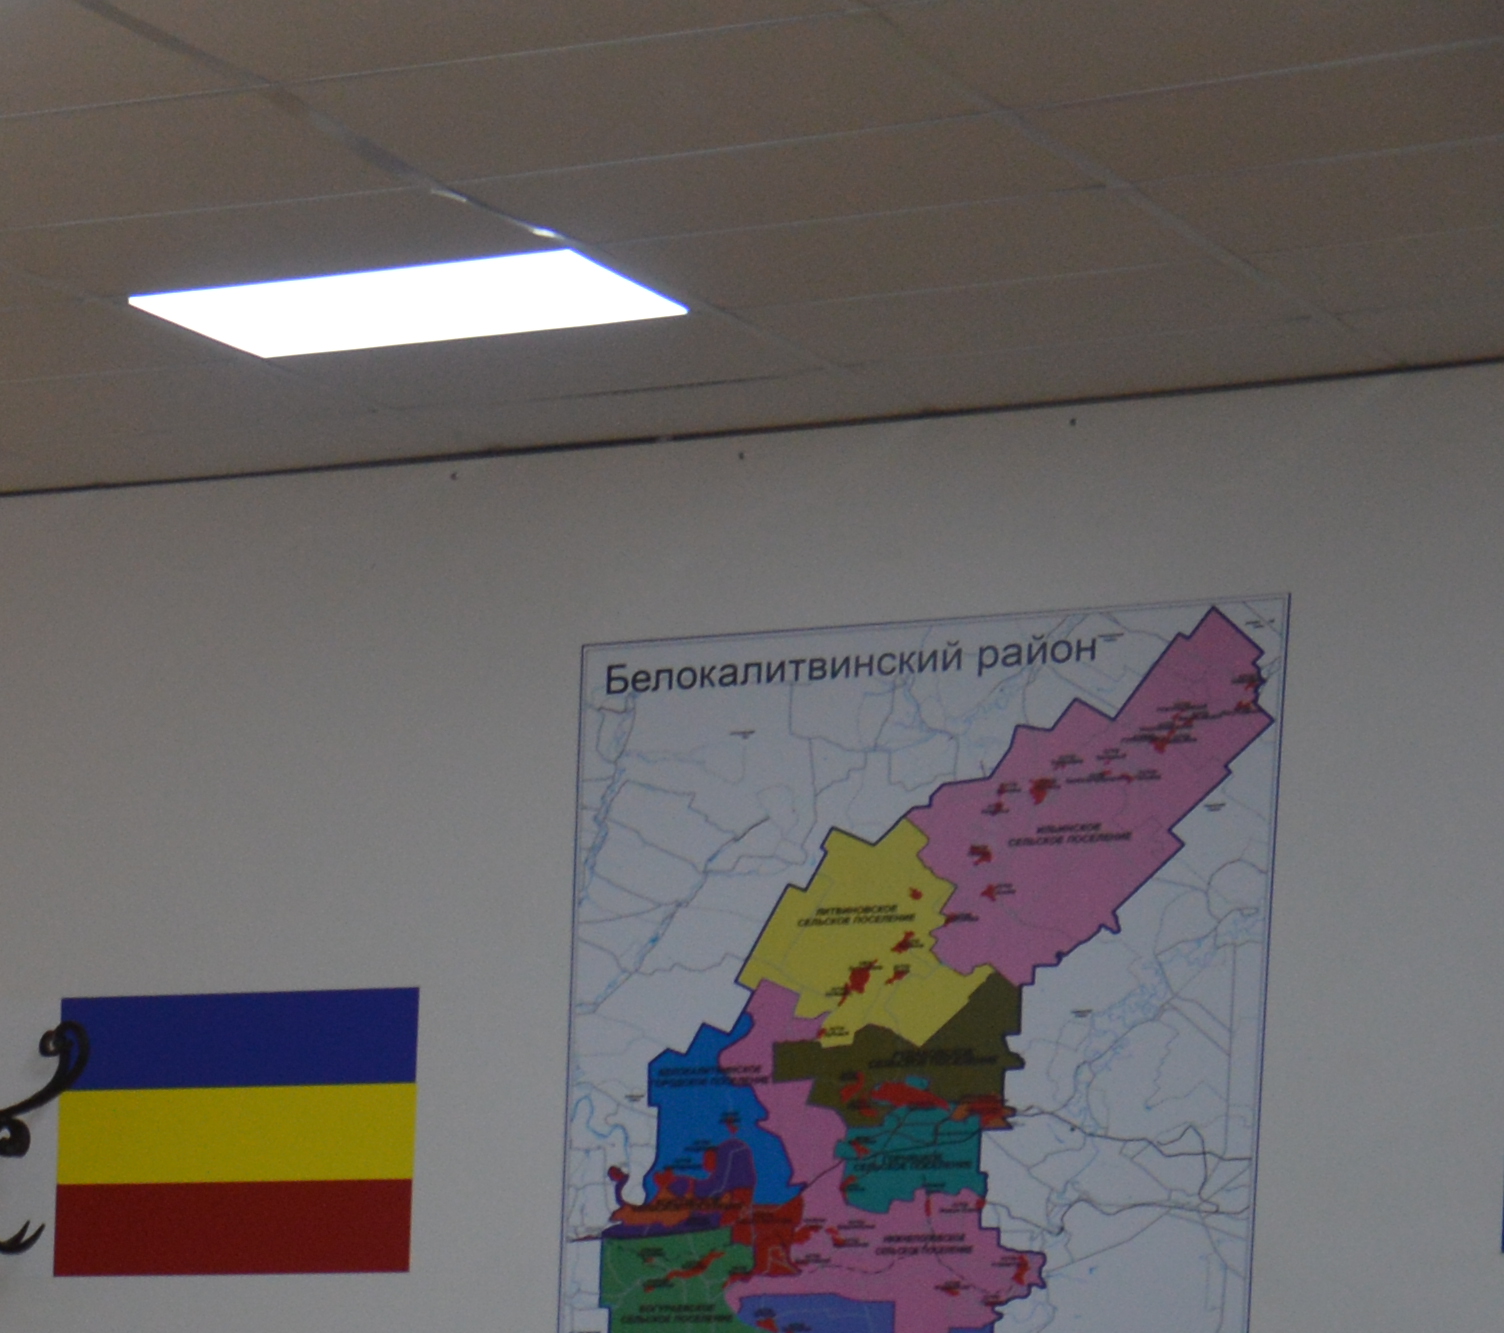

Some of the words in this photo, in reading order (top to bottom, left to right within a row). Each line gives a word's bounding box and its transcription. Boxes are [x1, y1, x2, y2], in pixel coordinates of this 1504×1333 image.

[604, 640, 964, 695] Белокалитвинский
[976, 634, 1097, 677] район
[1007, 836, 1064, 847] СЕЛЬСКОЕ
[1066, 831, 1132, 843] ПОСЕЛЕНИЕ
[797, 916, 850, 927] СЕЛЬСКОЕ
[853, 912, 916, 924] ПОСЕЛЕНИЕ
